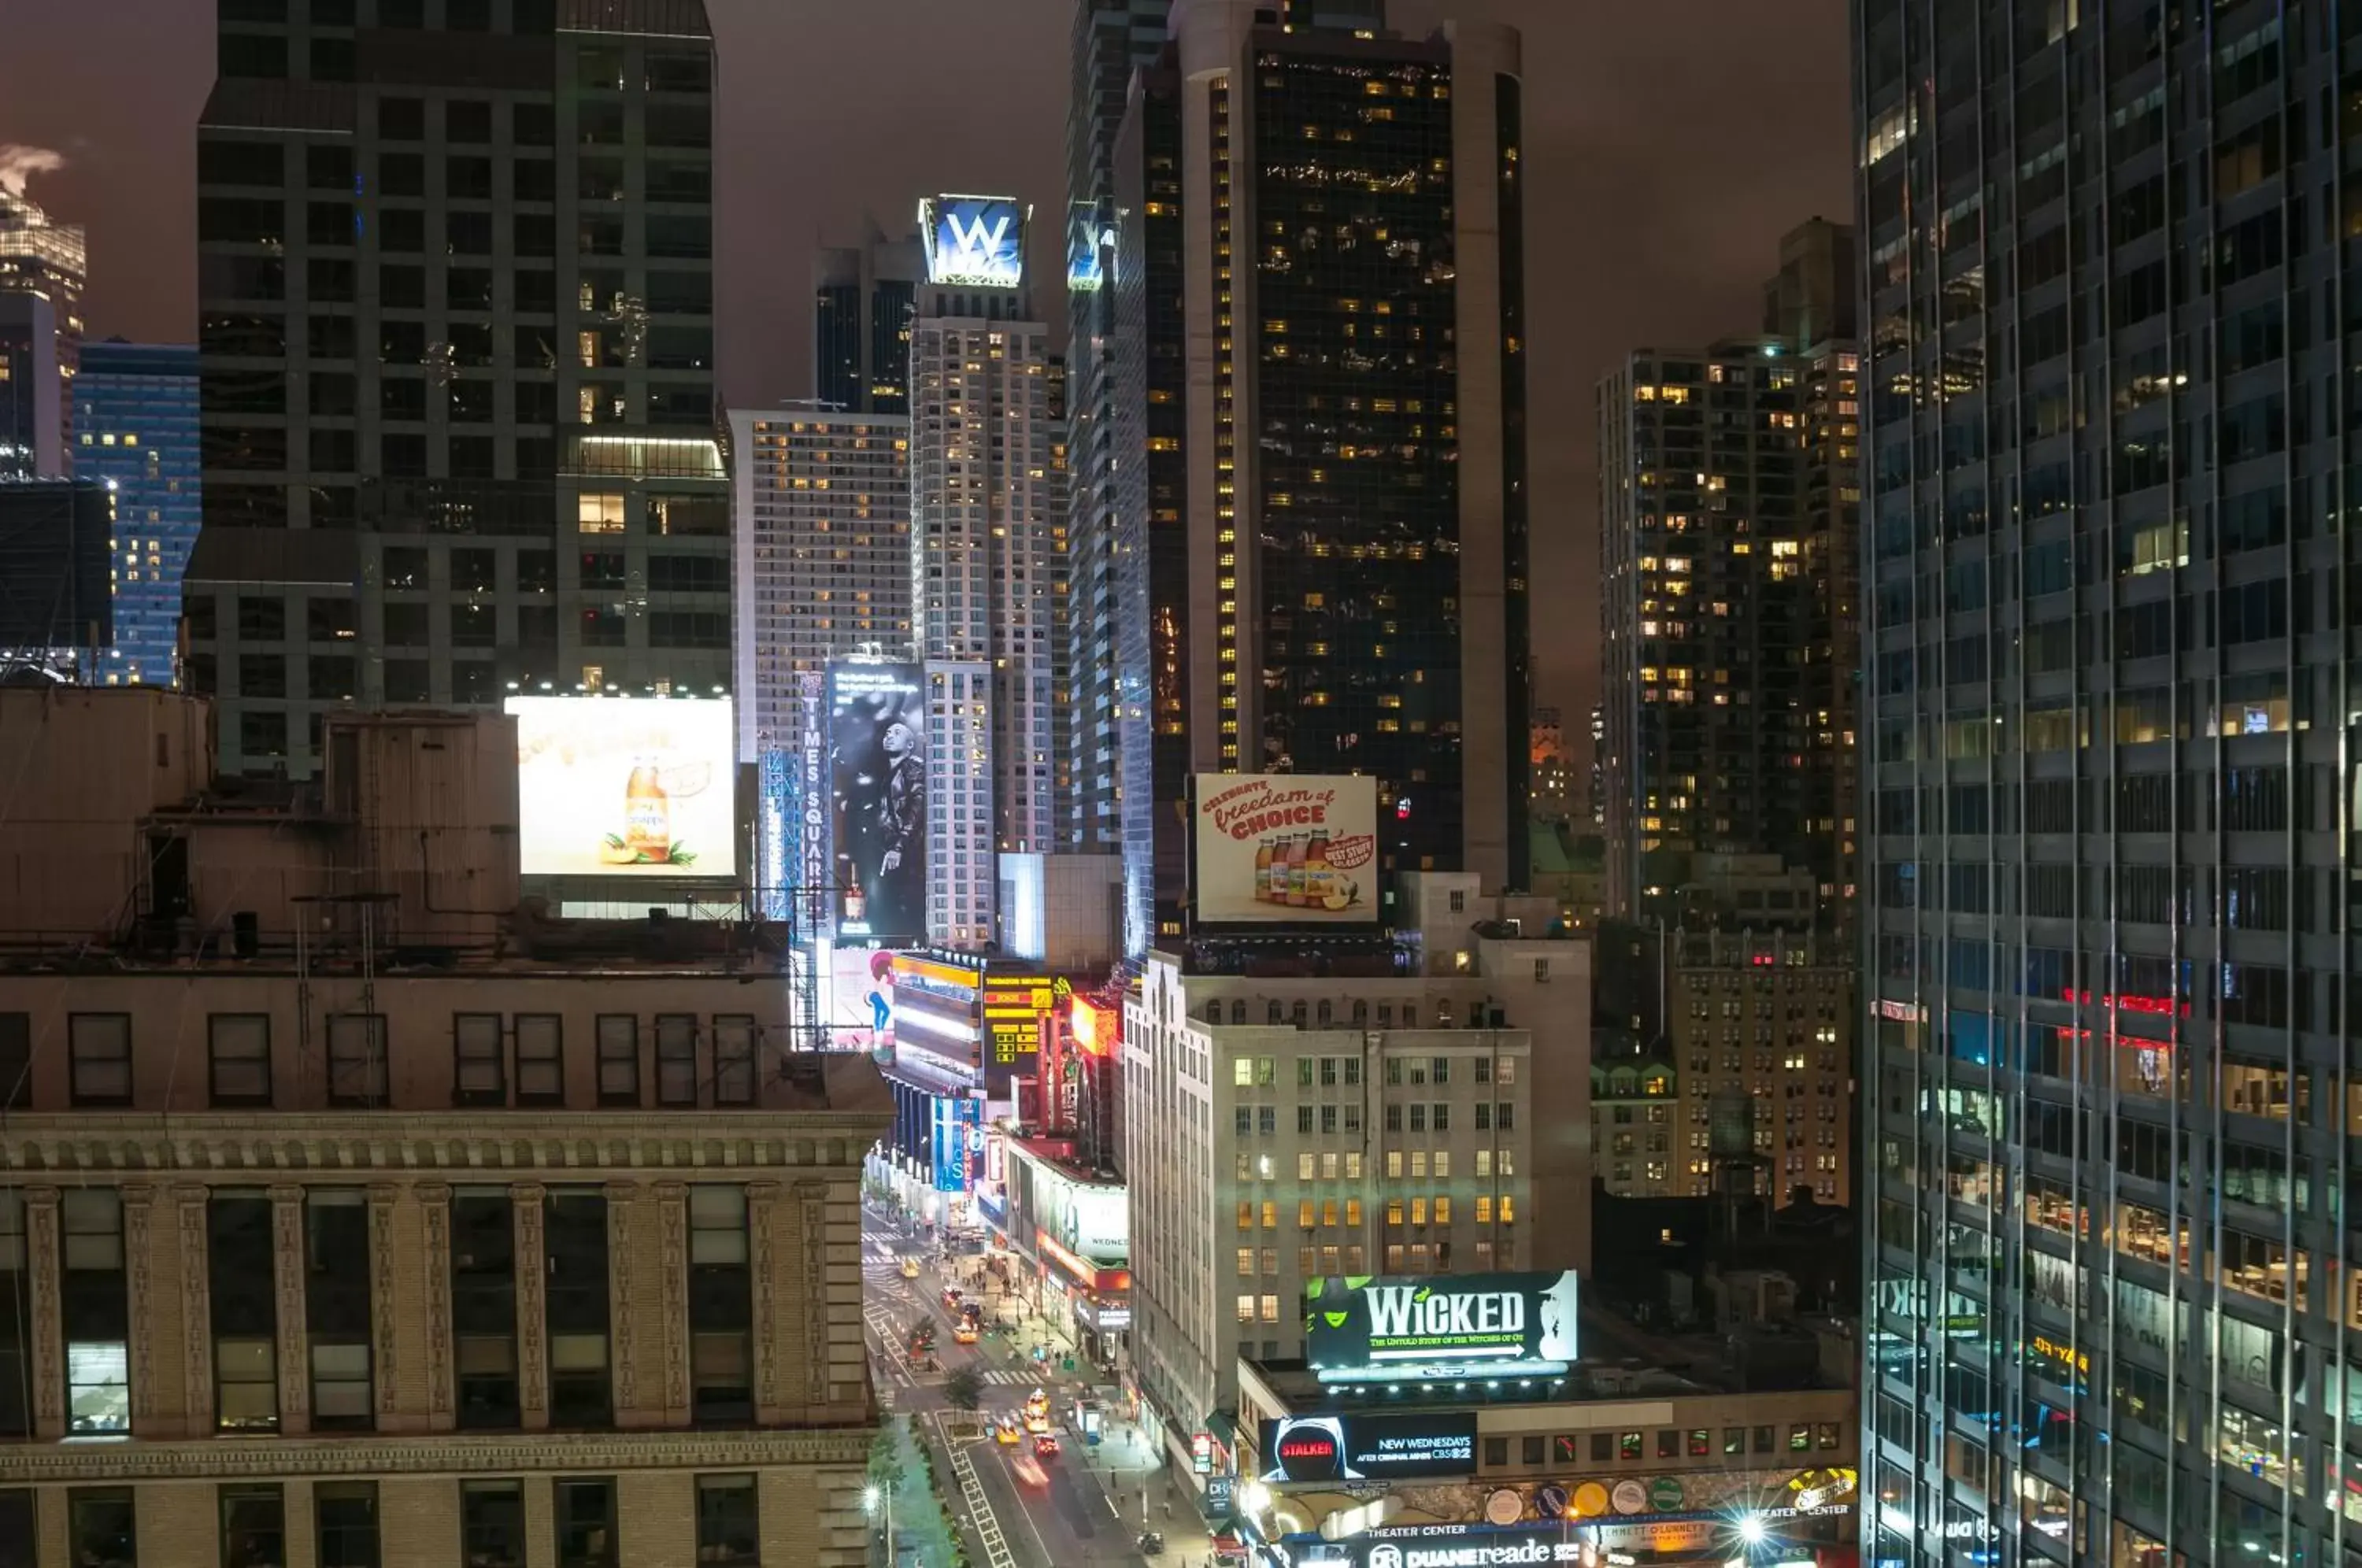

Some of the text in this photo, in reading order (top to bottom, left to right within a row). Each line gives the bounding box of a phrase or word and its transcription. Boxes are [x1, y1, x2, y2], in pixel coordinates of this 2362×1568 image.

[946, 213, 1010, 260] W
[803, 697, 821, 783] TIMES
[1202, 780, 1268, 813] CELEBRATE
[1214, 789, 1336, 833] freedom of
[1231, 805, 1326, 841] CHOICE
[805, 791, 823, 895] SQUARE
[1281, 1442, 1333, 1457] STALKER
[1379, 1437, 1471, 1449] NEW WEDNESDAYS
[1798, 1478, 1850, 1509] Snapple
[1751, 1505, 1849, 1518] THEATER CENTER
[1368, 1527, 1418, 1537] THEATER
[1423, 1525, 1466, 1537] CENTER
